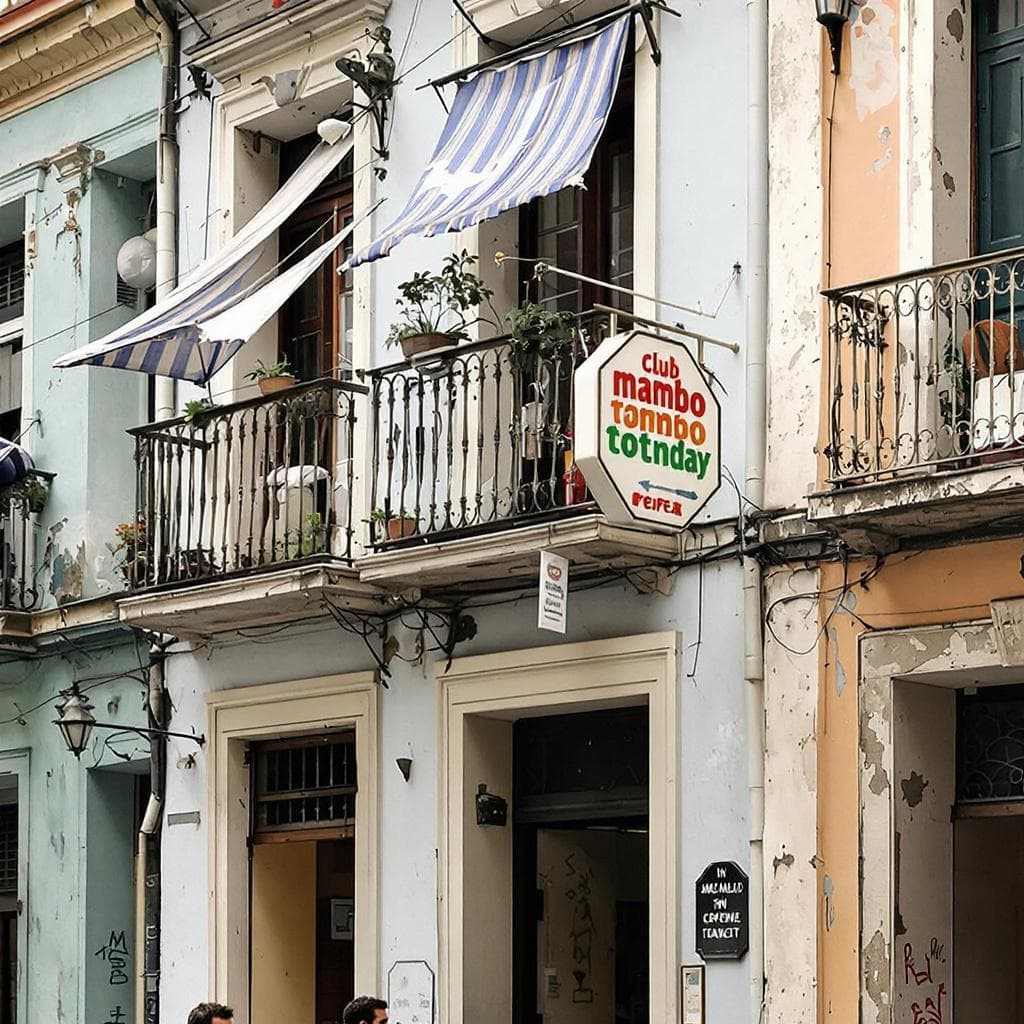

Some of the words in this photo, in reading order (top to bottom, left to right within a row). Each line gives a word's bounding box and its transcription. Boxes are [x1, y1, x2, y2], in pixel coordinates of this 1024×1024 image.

[641, 352, 680, 379] club
[613, 370, 706, 418] mambo
[606, 425, 712, 480] totnday
